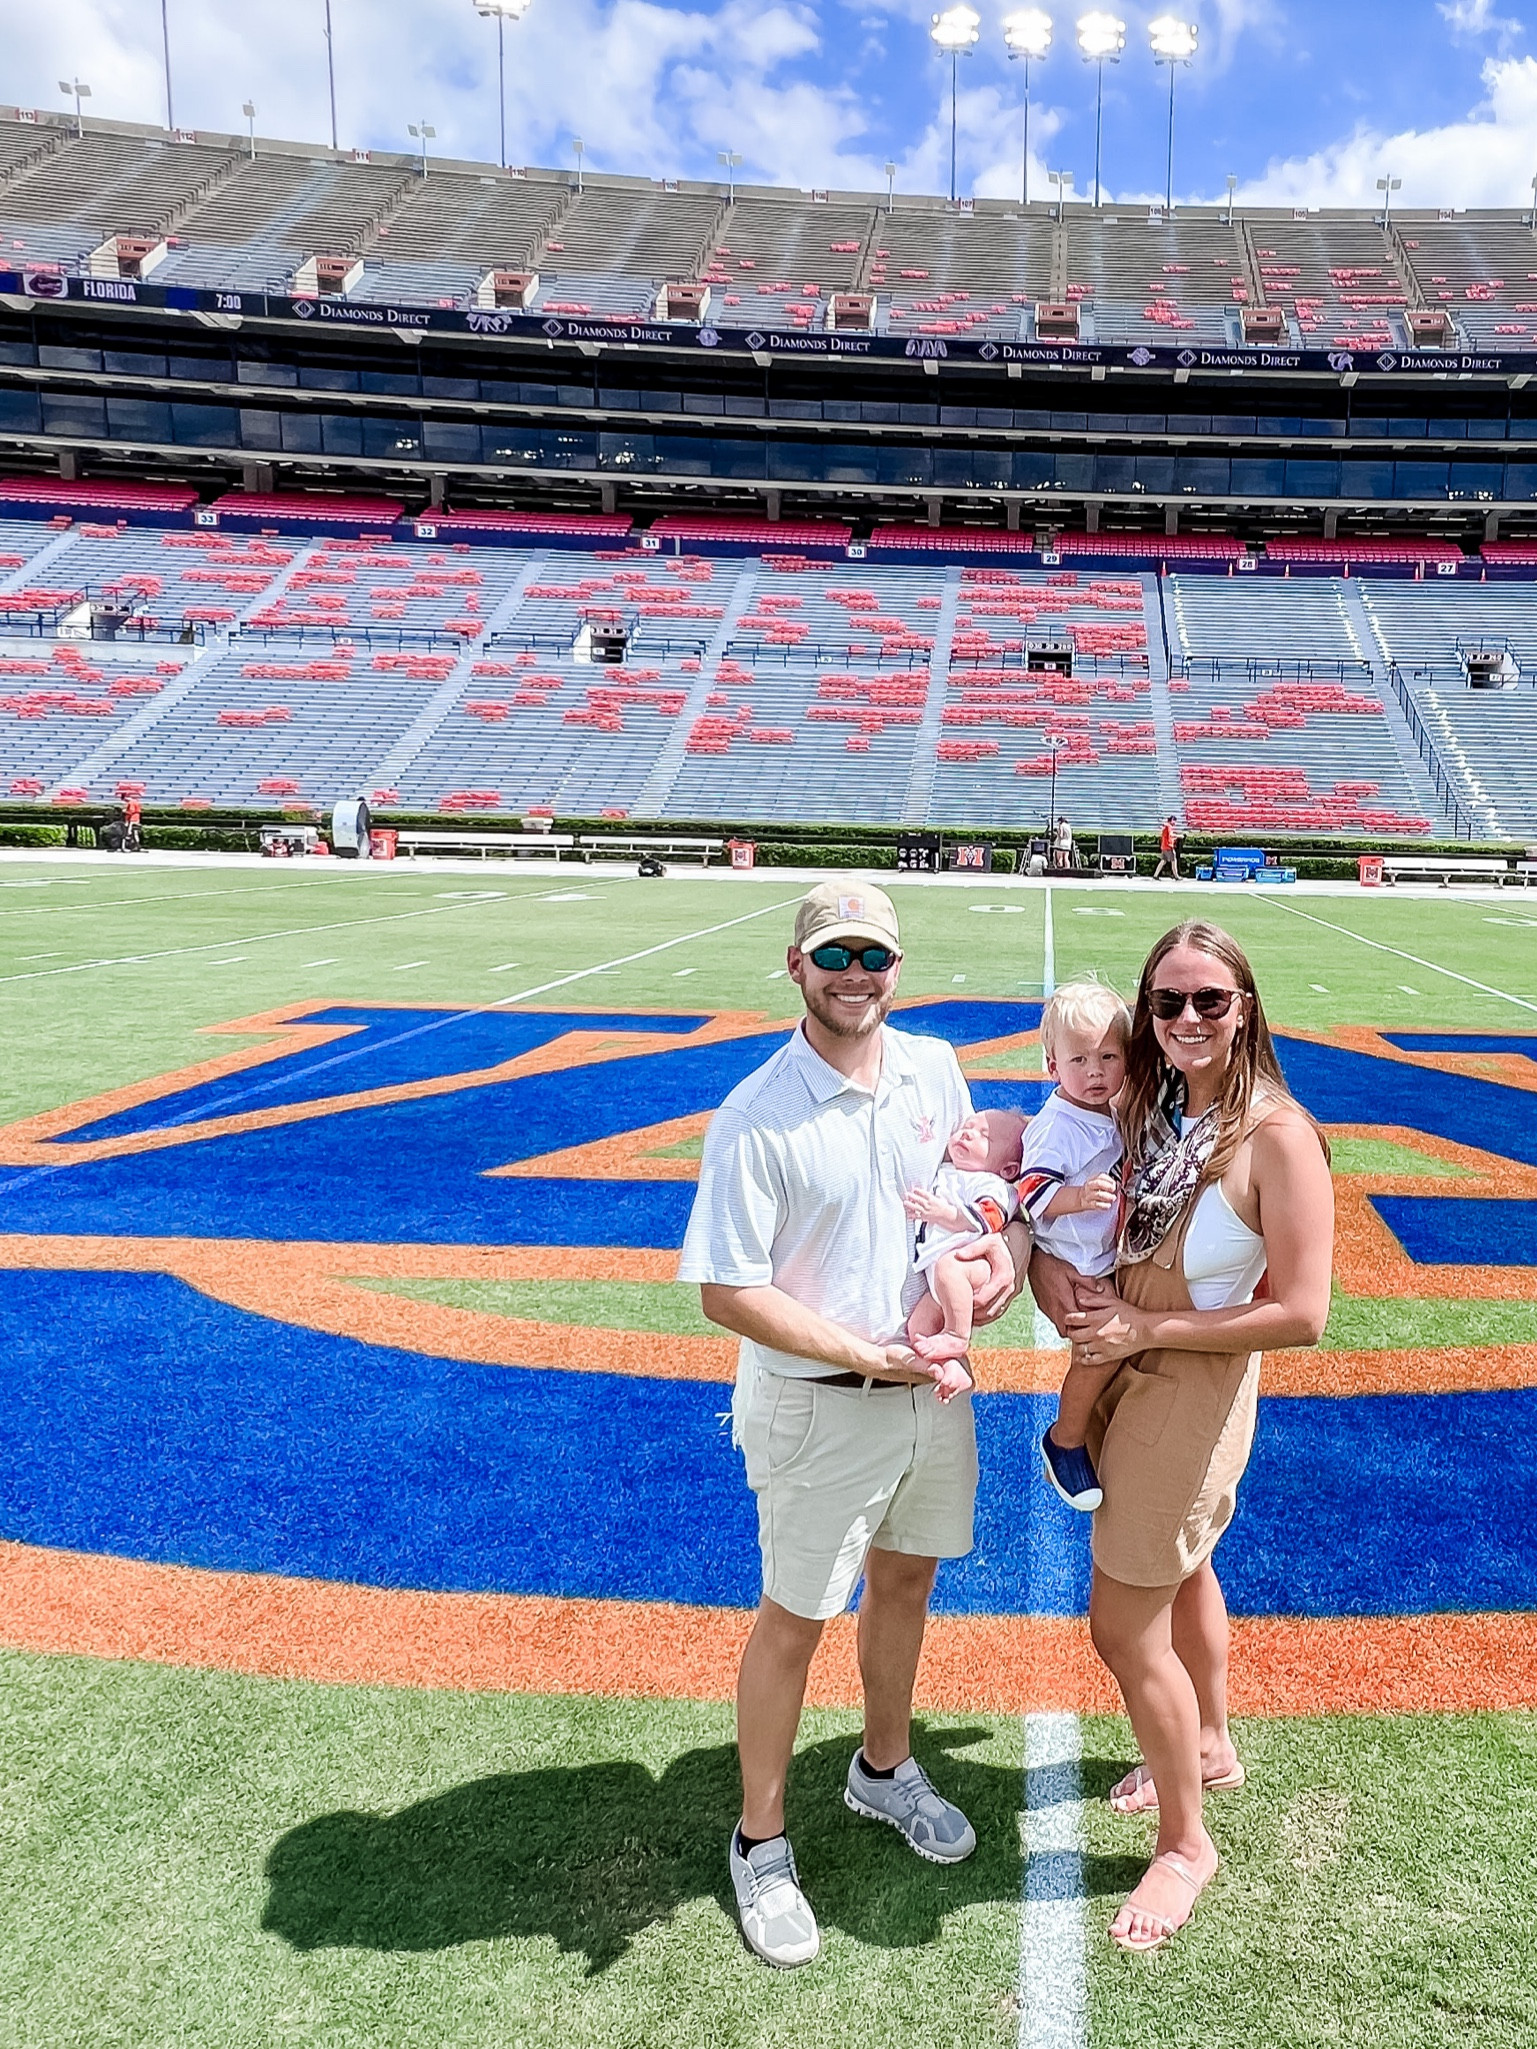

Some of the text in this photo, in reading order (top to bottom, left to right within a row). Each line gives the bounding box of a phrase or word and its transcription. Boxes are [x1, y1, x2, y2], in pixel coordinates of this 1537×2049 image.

[83, 280, 137, 301] FLORIDA
[215, 293, 242, 310] 7:00
[320, 303, 431, 325] DIAMONDS DIRECT
[568, 322, 673, 341] DIAMONDS DIRECT
[770, 335, 871, 352] DIAMONDS DIRECT
[1003, 345, 1102, 362] DIAMONDS DIRECT
[1201, 352, 1301, 367] DIAMONDS DIRECT
[1400, 355, 1502, 369] DIAMONDS DIRECT
[201, 514, 214, 523] 33
[420, 527, 433, 536] 32
[645, 538, 657, 547] 31
[851, 548, 863, 556] 30
[1046, 555, 1058, 563] 29
[1242, 560, 1253, 569] 28
[1440, 563, 1454, 573] 27
